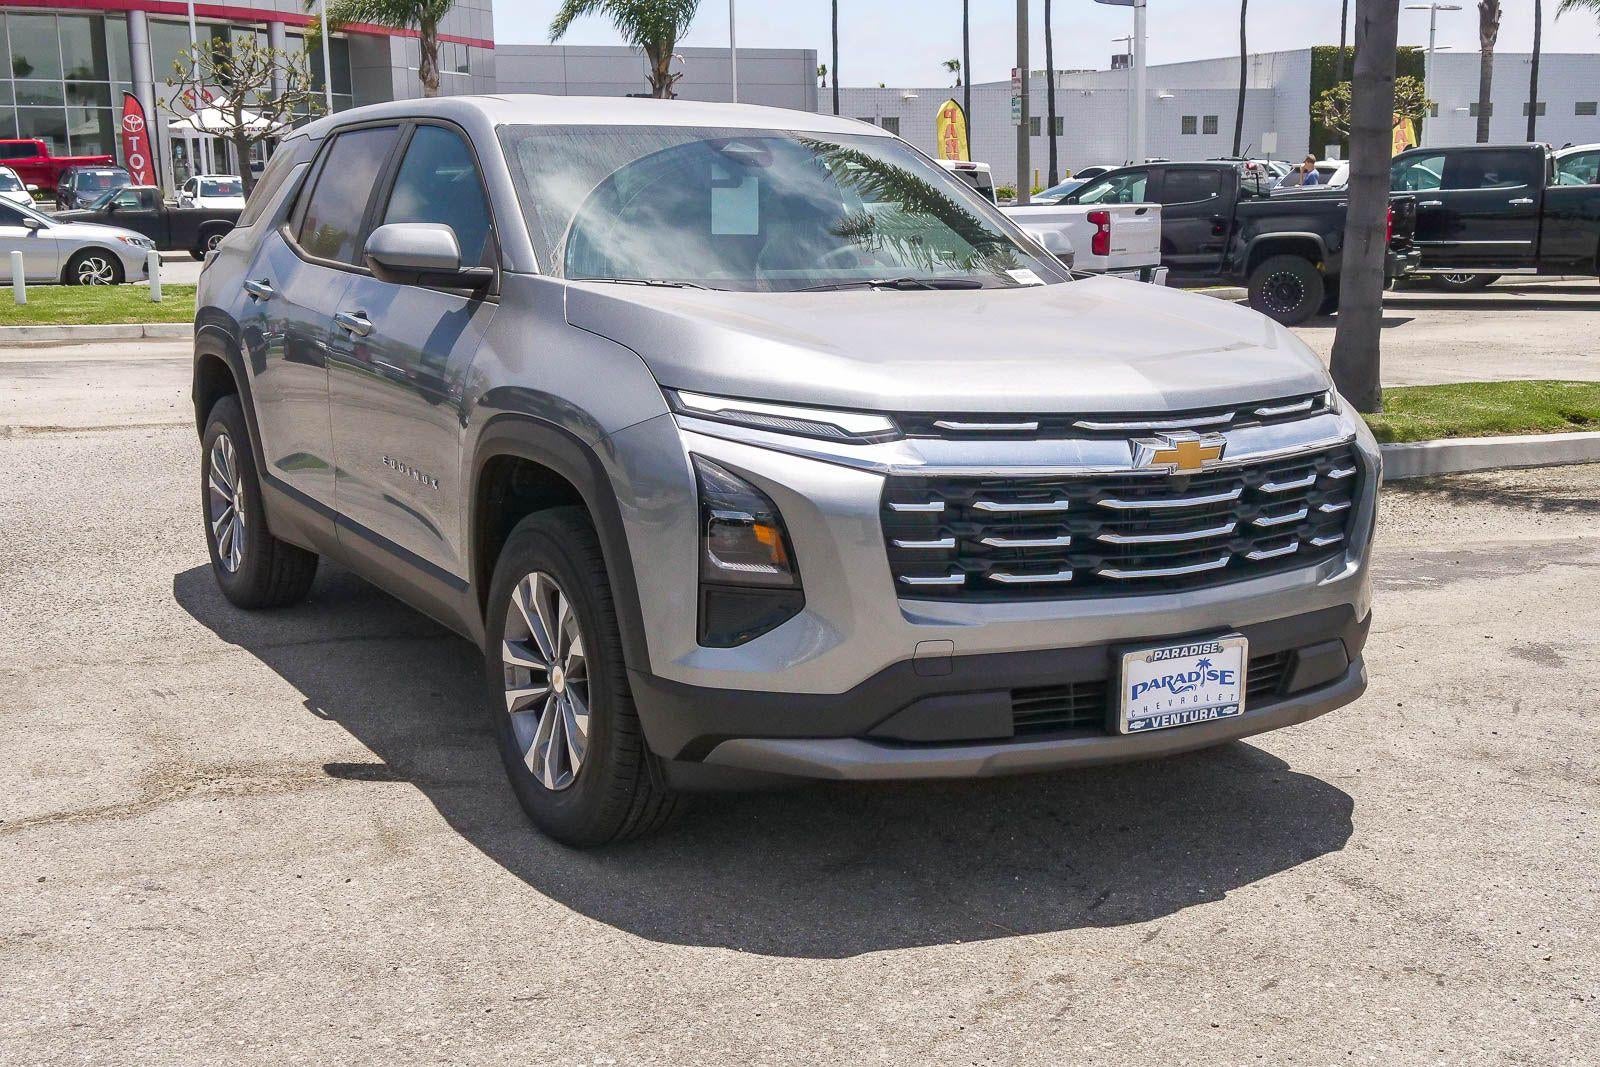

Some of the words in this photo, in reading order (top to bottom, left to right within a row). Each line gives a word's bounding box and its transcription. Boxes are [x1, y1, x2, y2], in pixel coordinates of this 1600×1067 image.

[382, 455, 439, 490] EQUINOX
[1153, 643, 1219, 661] PARADISE
[1131, 658, 1235, 700] PARADISE
[1131, 693, 1235, 718] CHEVROLET
[1151, 708, 1218, 728] VENTURA
